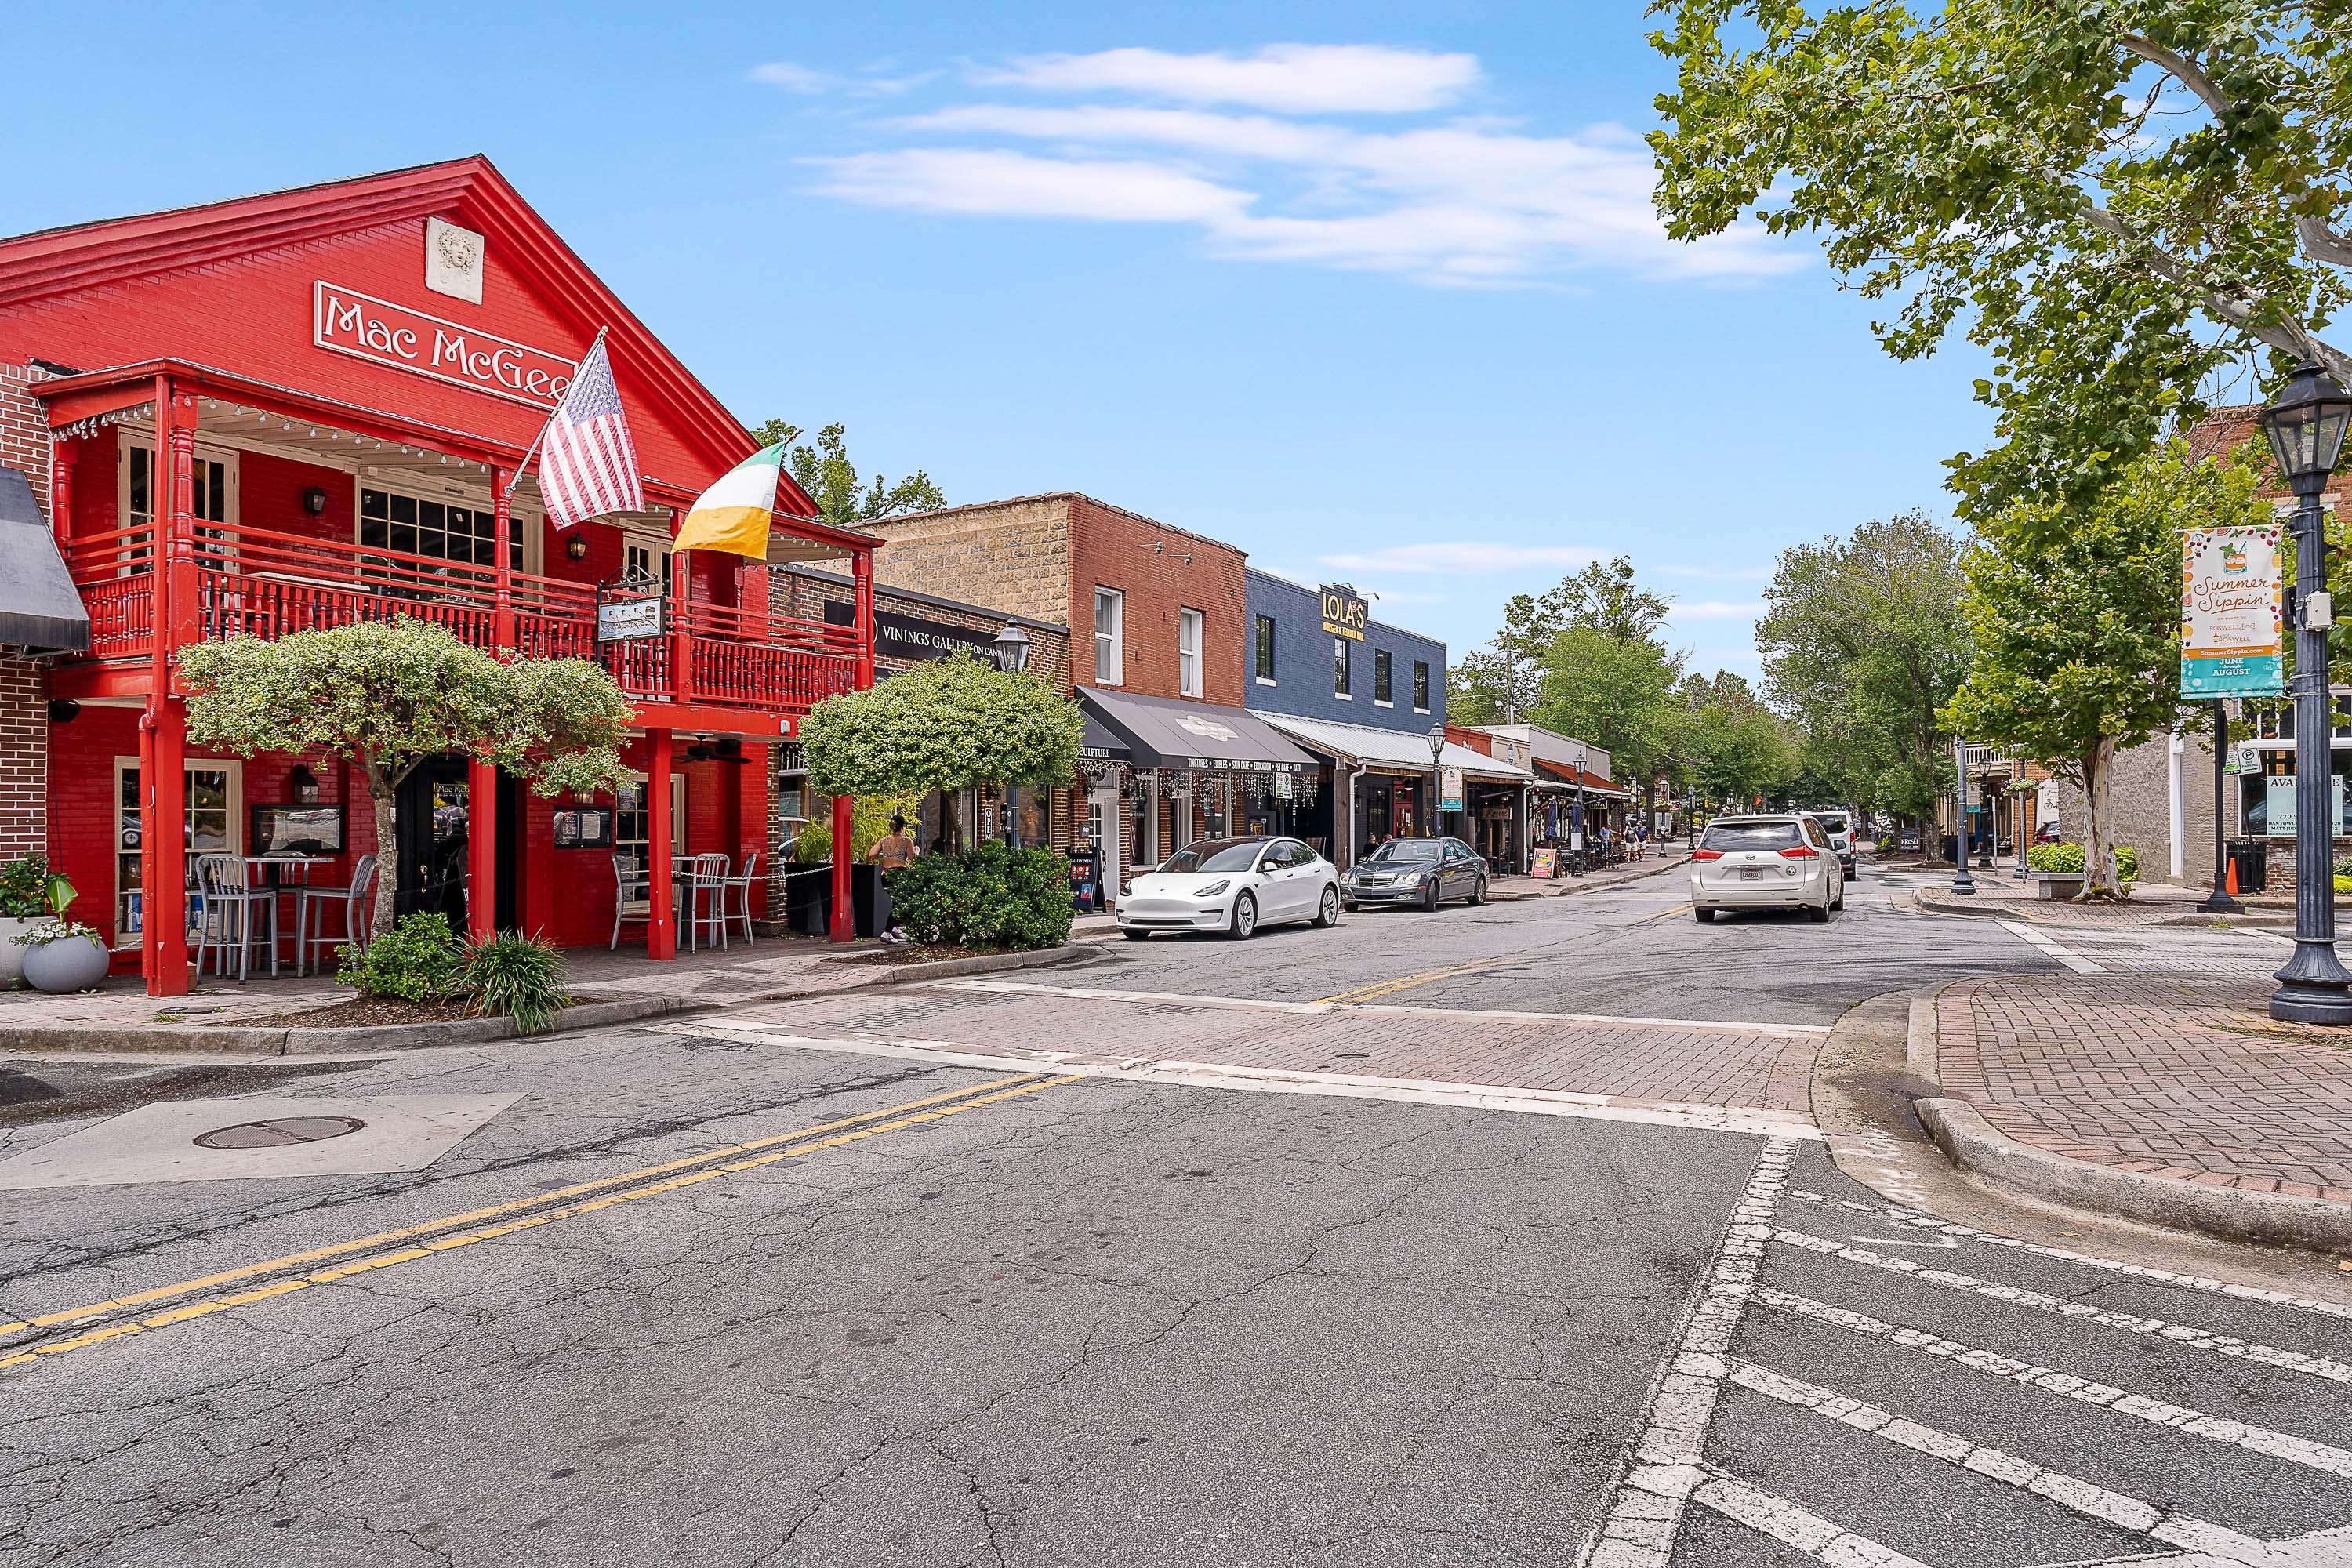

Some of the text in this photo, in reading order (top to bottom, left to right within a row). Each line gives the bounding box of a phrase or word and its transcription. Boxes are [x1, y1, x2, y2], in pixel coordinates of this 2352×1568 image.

[322, 295, 571, 401] Mac McGee
[2194, 576, 2270, 596] Summer
[883, 626, 930, 646] VININGS
[973, 644, 984, 655] ON
